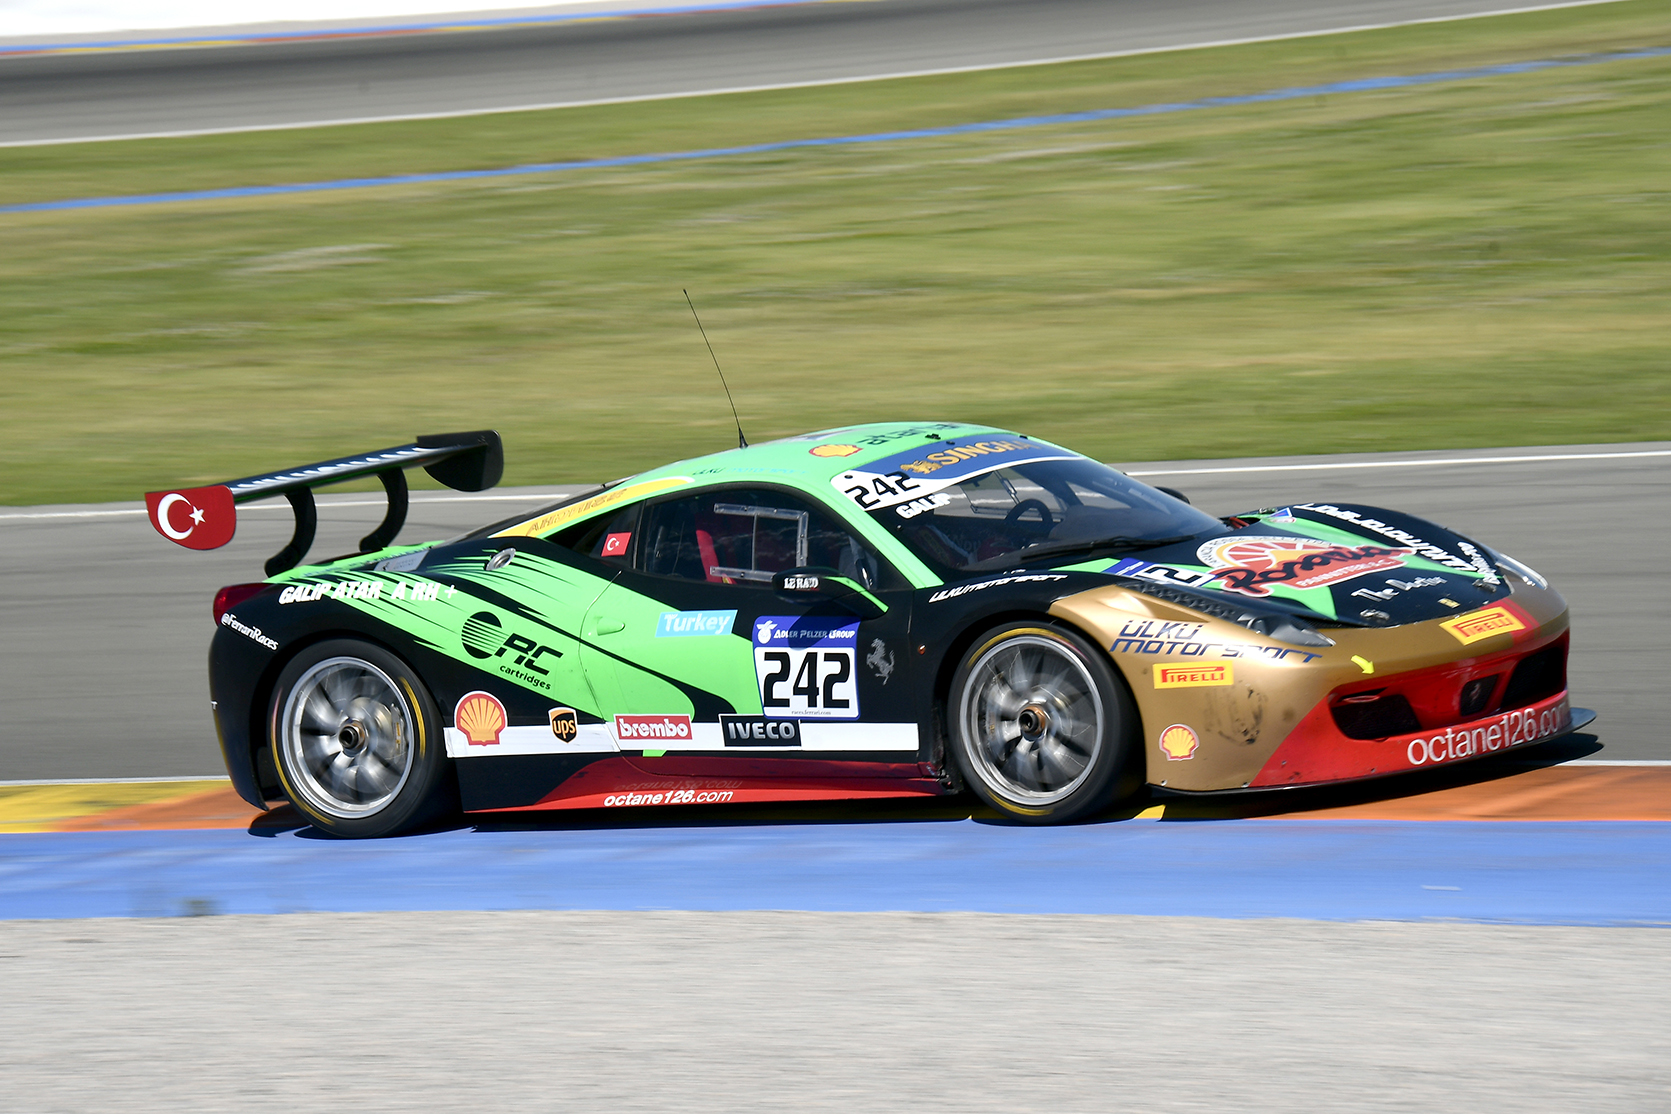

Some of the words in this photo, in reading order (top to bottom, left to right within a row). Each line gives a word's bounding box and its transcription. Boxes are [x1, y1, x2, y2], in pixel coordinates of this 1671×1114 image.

[931, 440, 1041, 466] SINGHA
[844, 471, 920, 509] 242
[331, 581, 384, 599] ATAR
[391, 582, 407, 600] A
[410, 582, 441, 601] RH
[220, 612, 279, 651] @FerrariRaces
[664, 612, 731, 635] Turkey
[1452, 612, 1514, 638] PIRELLI
[499, 665, 552, 690] cartridges
[763, 651, 851, 709] 242
[1161, 666, 1225, 683] PIRELLI
[553, 719, 577, 736] ups
[619, 717, 689, 738] brembo
[727, 721, 796, 740] IVECO
[603, 789, 734, 807] octane126.com
